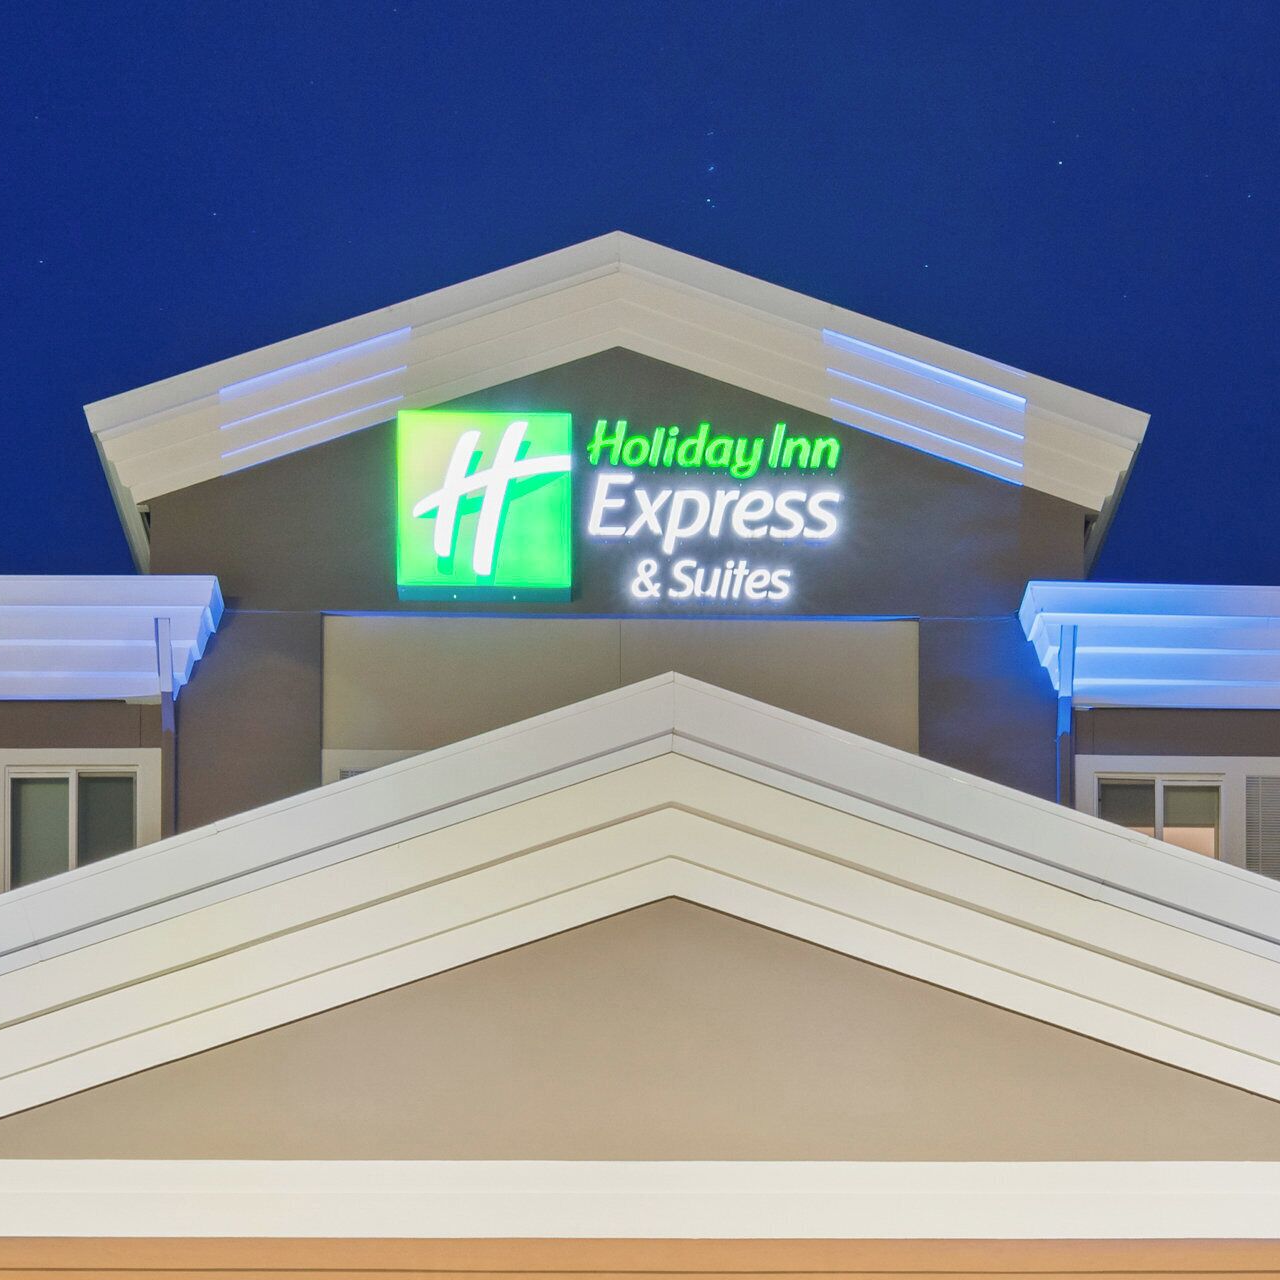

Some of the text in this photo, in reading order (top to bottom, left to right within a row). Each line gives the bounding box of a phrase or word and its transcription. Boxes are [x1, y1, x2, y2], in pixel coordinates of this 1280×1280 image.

[587, 420, 841, 479] Holiday Inn
[587, 473, 841, 555] Express
[630, 558, 791, 600] & Suites
